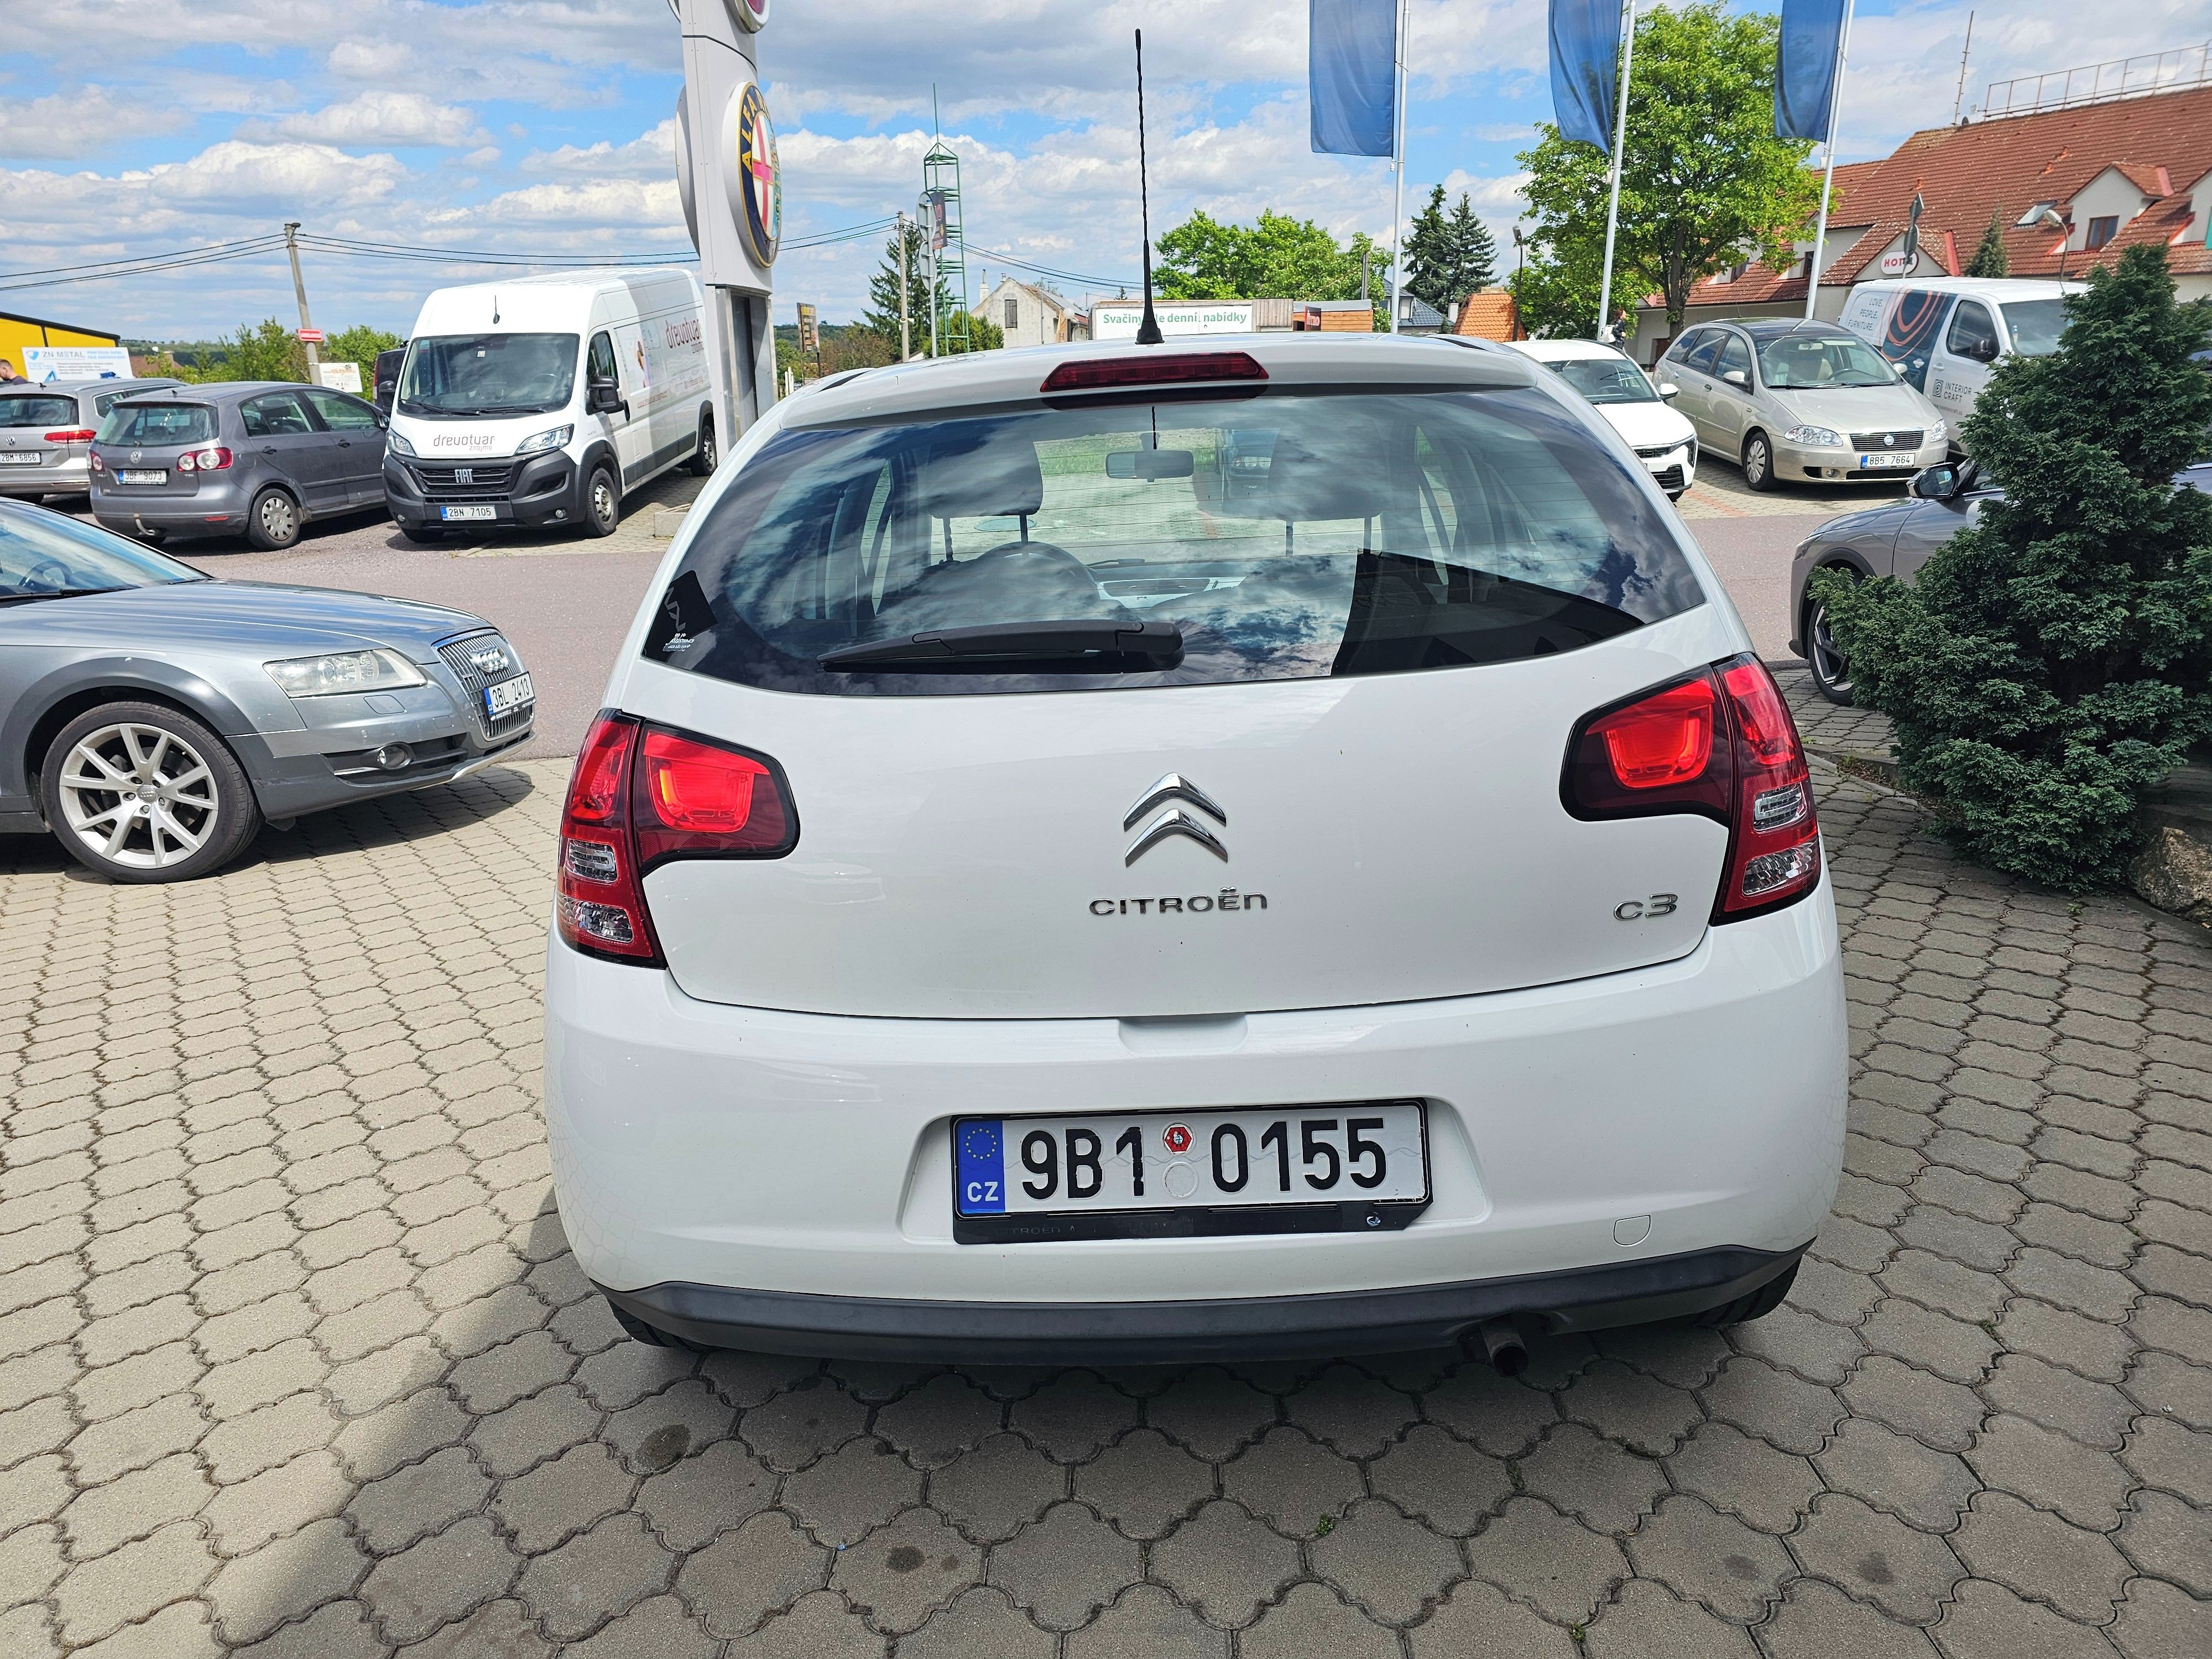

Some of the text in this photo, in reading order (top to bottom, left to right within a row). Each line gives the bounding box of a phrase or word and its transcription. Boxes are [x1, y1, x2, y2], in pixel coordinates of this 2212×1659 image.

[1167, 312, 1197, 322] denní
[1204, 312, 1247, 324] nabídky
[1945, 382, 1972, 395] INTERIOR
[1944, 392, 1963, 403] CRAFT
[1870, 456, 1910, 465] 8B5 7664
[144, 470, 162, 480] 9073
[455, 469, 473, 483] FIAT
[448, 508, 465, 517] 2BN
[470, 508, 491, 516] 7105
[492, 677, 529, 708] 3BL 2413
[1614, 893, 1678, 920] C3
[1021, 1117, 1387, 1200] 9B1 0155
[967, 1181, 999, 1203] CZ
